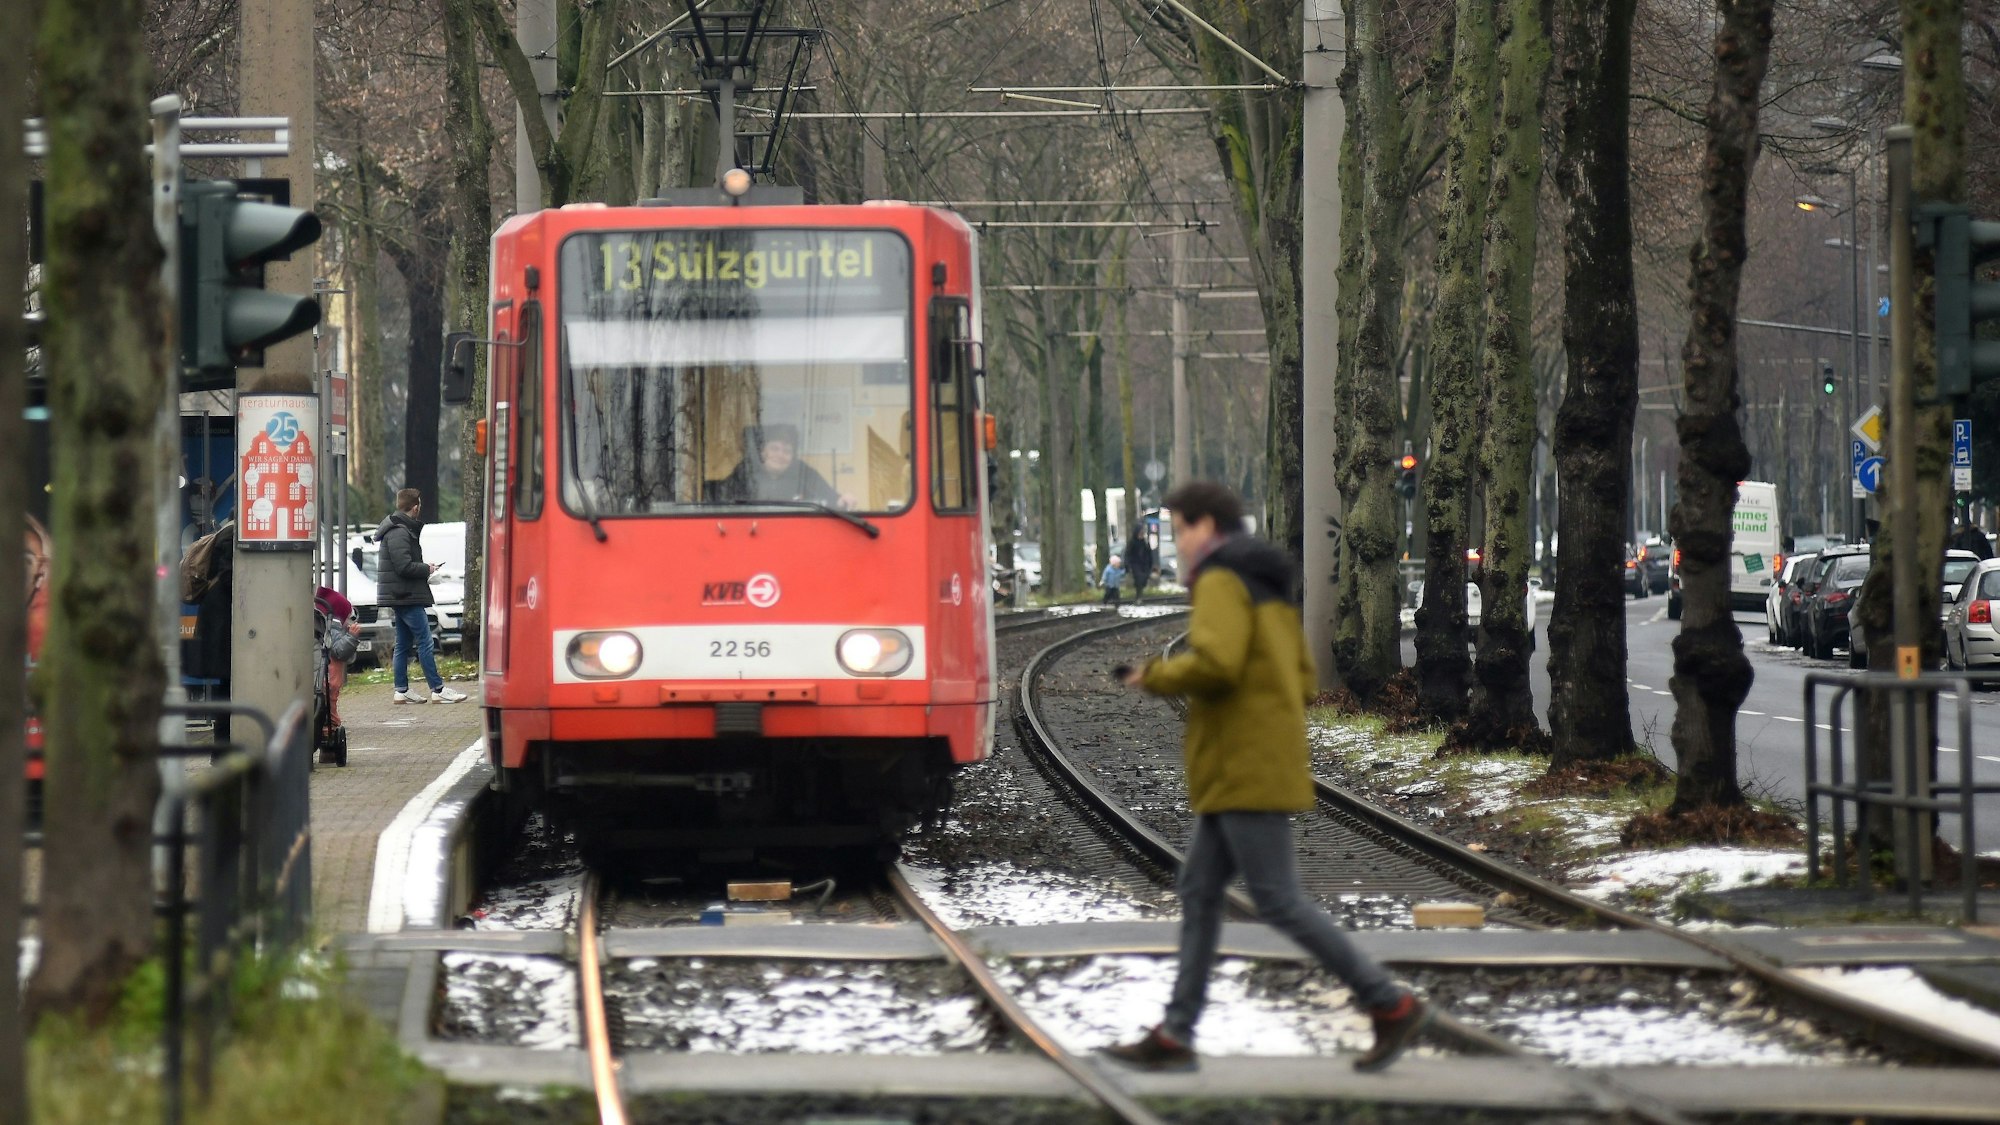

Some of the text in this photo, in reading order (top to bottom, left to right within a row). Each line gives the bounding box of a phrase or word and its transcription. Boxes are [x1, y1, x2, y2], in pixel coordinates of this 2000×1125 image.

[600, 239, 873, 291] 13 Sülzgürtel
[268, 415, 298, 442] 25
[1734, 521, 1767, 533] nland
[703, 581, 745, 601] KVB
[710, 640, 771, 658] 2256
